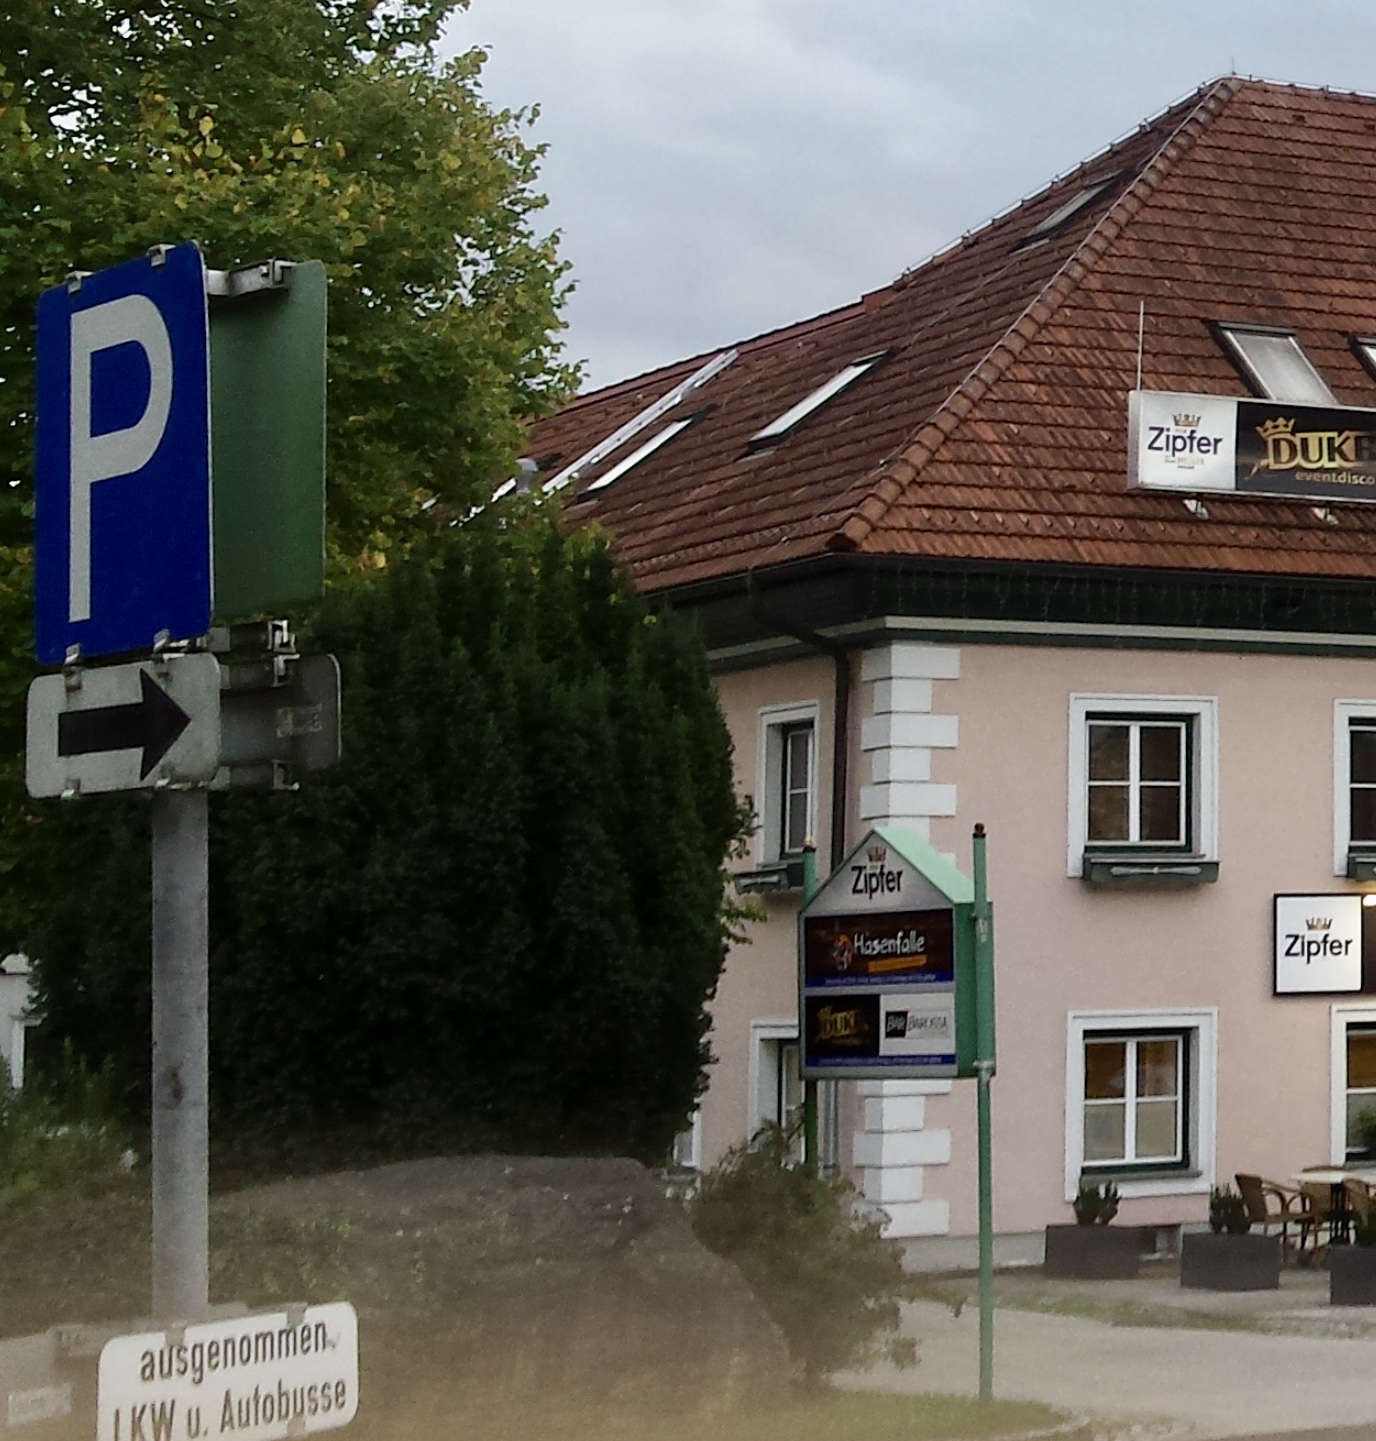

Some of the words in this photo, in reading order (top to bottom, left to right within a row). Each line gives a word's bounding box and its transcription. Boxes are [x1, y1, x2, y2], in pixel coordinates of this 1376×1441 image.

[69, 294, 173, 623] P
[1147, 425, 1223, 458] Zipfer
[851, 864, 903, 900] Zipfer
[854, 930, 926, 955] Hasenfalle
[1285, 933, 1353, 965] Zipfer
[140, 1321, 328, 1385] ausgenommen
[187, 1407, 208, 1439] u.
[219, 1378, 347, 1434] Autobusse
